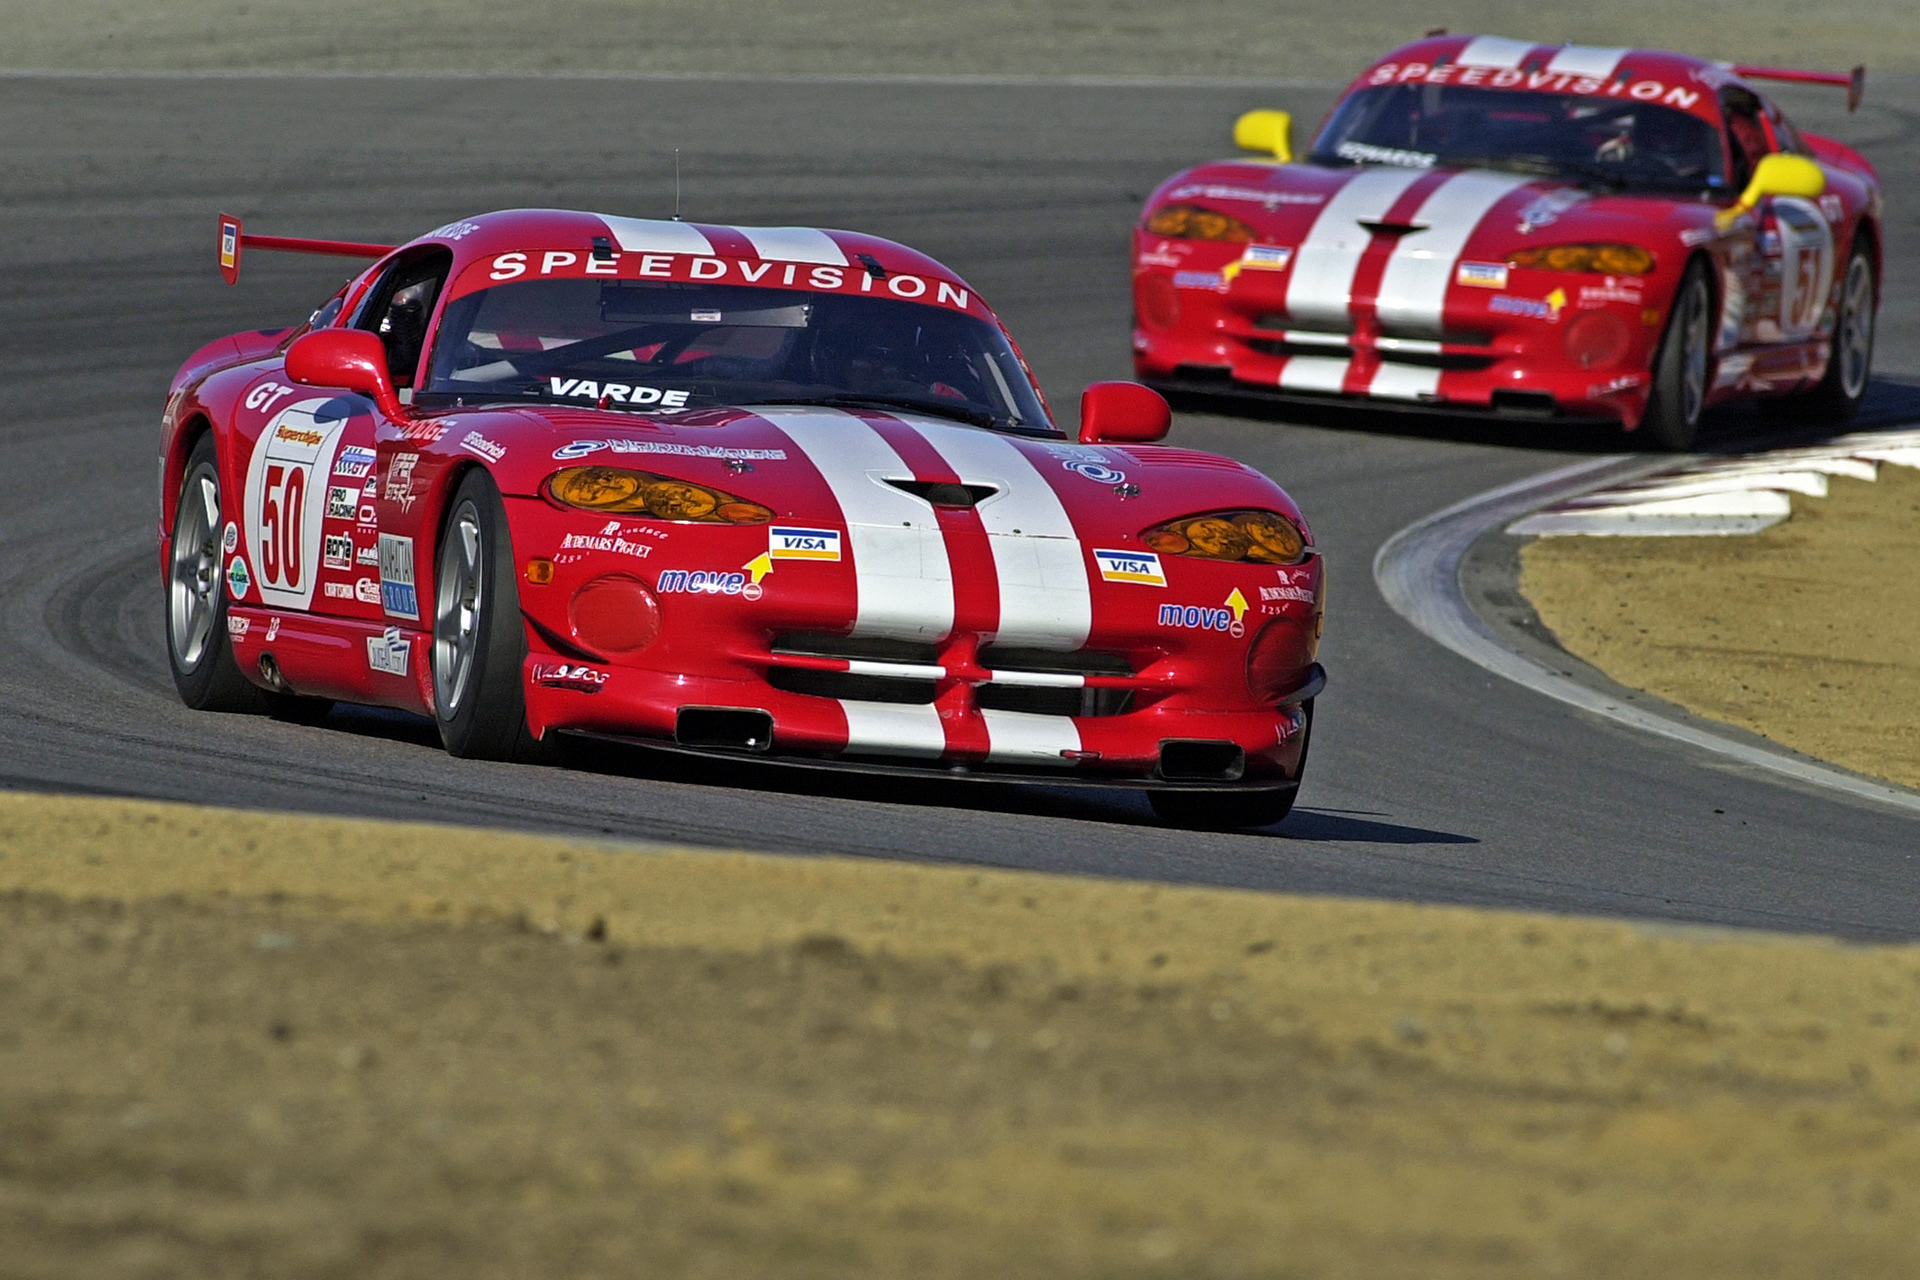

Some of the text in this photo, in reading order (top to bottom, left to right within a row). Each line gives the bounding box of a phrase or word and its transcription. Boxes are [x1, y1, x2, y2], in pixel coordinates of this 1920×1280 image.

[1368, 62, 1699, 109] SPEEDVISION
[490, 251, 969, 309] SPEEDVISION
[245, 381, 294, 414] GT
[549, 376, 690, 407] VARDE
[330, 487, 347, 503] PRO
[262, 465, 305, 589] 50
[612, 537, 653, 558] PIGUET
[783, 536, 827, 551] VISA
[1109, 559, 1151, 575] VISA
[657, 569, 746, 595] move
[1157, 603, 1231, 632] move
